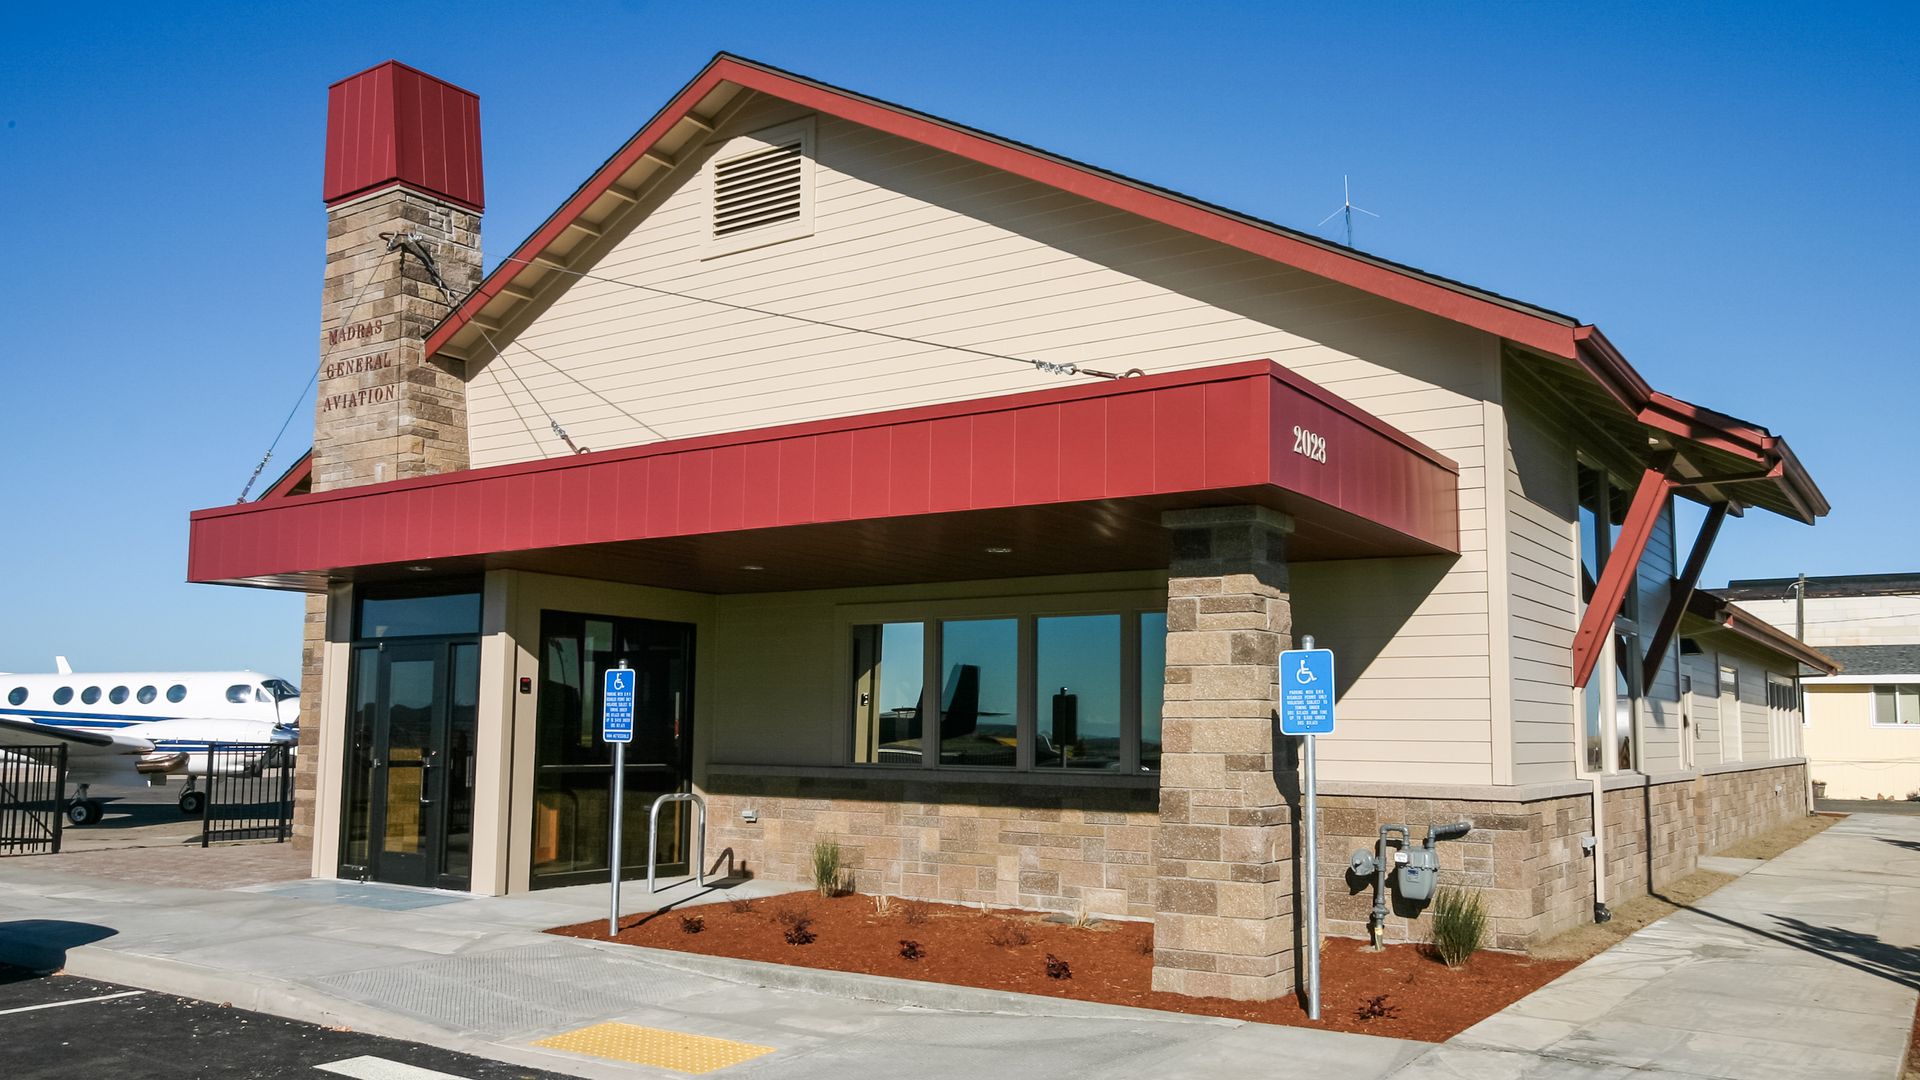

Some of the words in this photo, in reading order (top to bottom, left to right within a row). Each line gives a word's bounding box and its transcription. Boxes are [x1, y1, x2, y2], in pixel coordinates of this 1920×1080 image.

[328, 319, 383, 346] MADRAS
[326, 352, 391, 379] GENERAL
[323, 385, 395, 412] AVIATION
[1293, 425, 1326, 464] 2028
